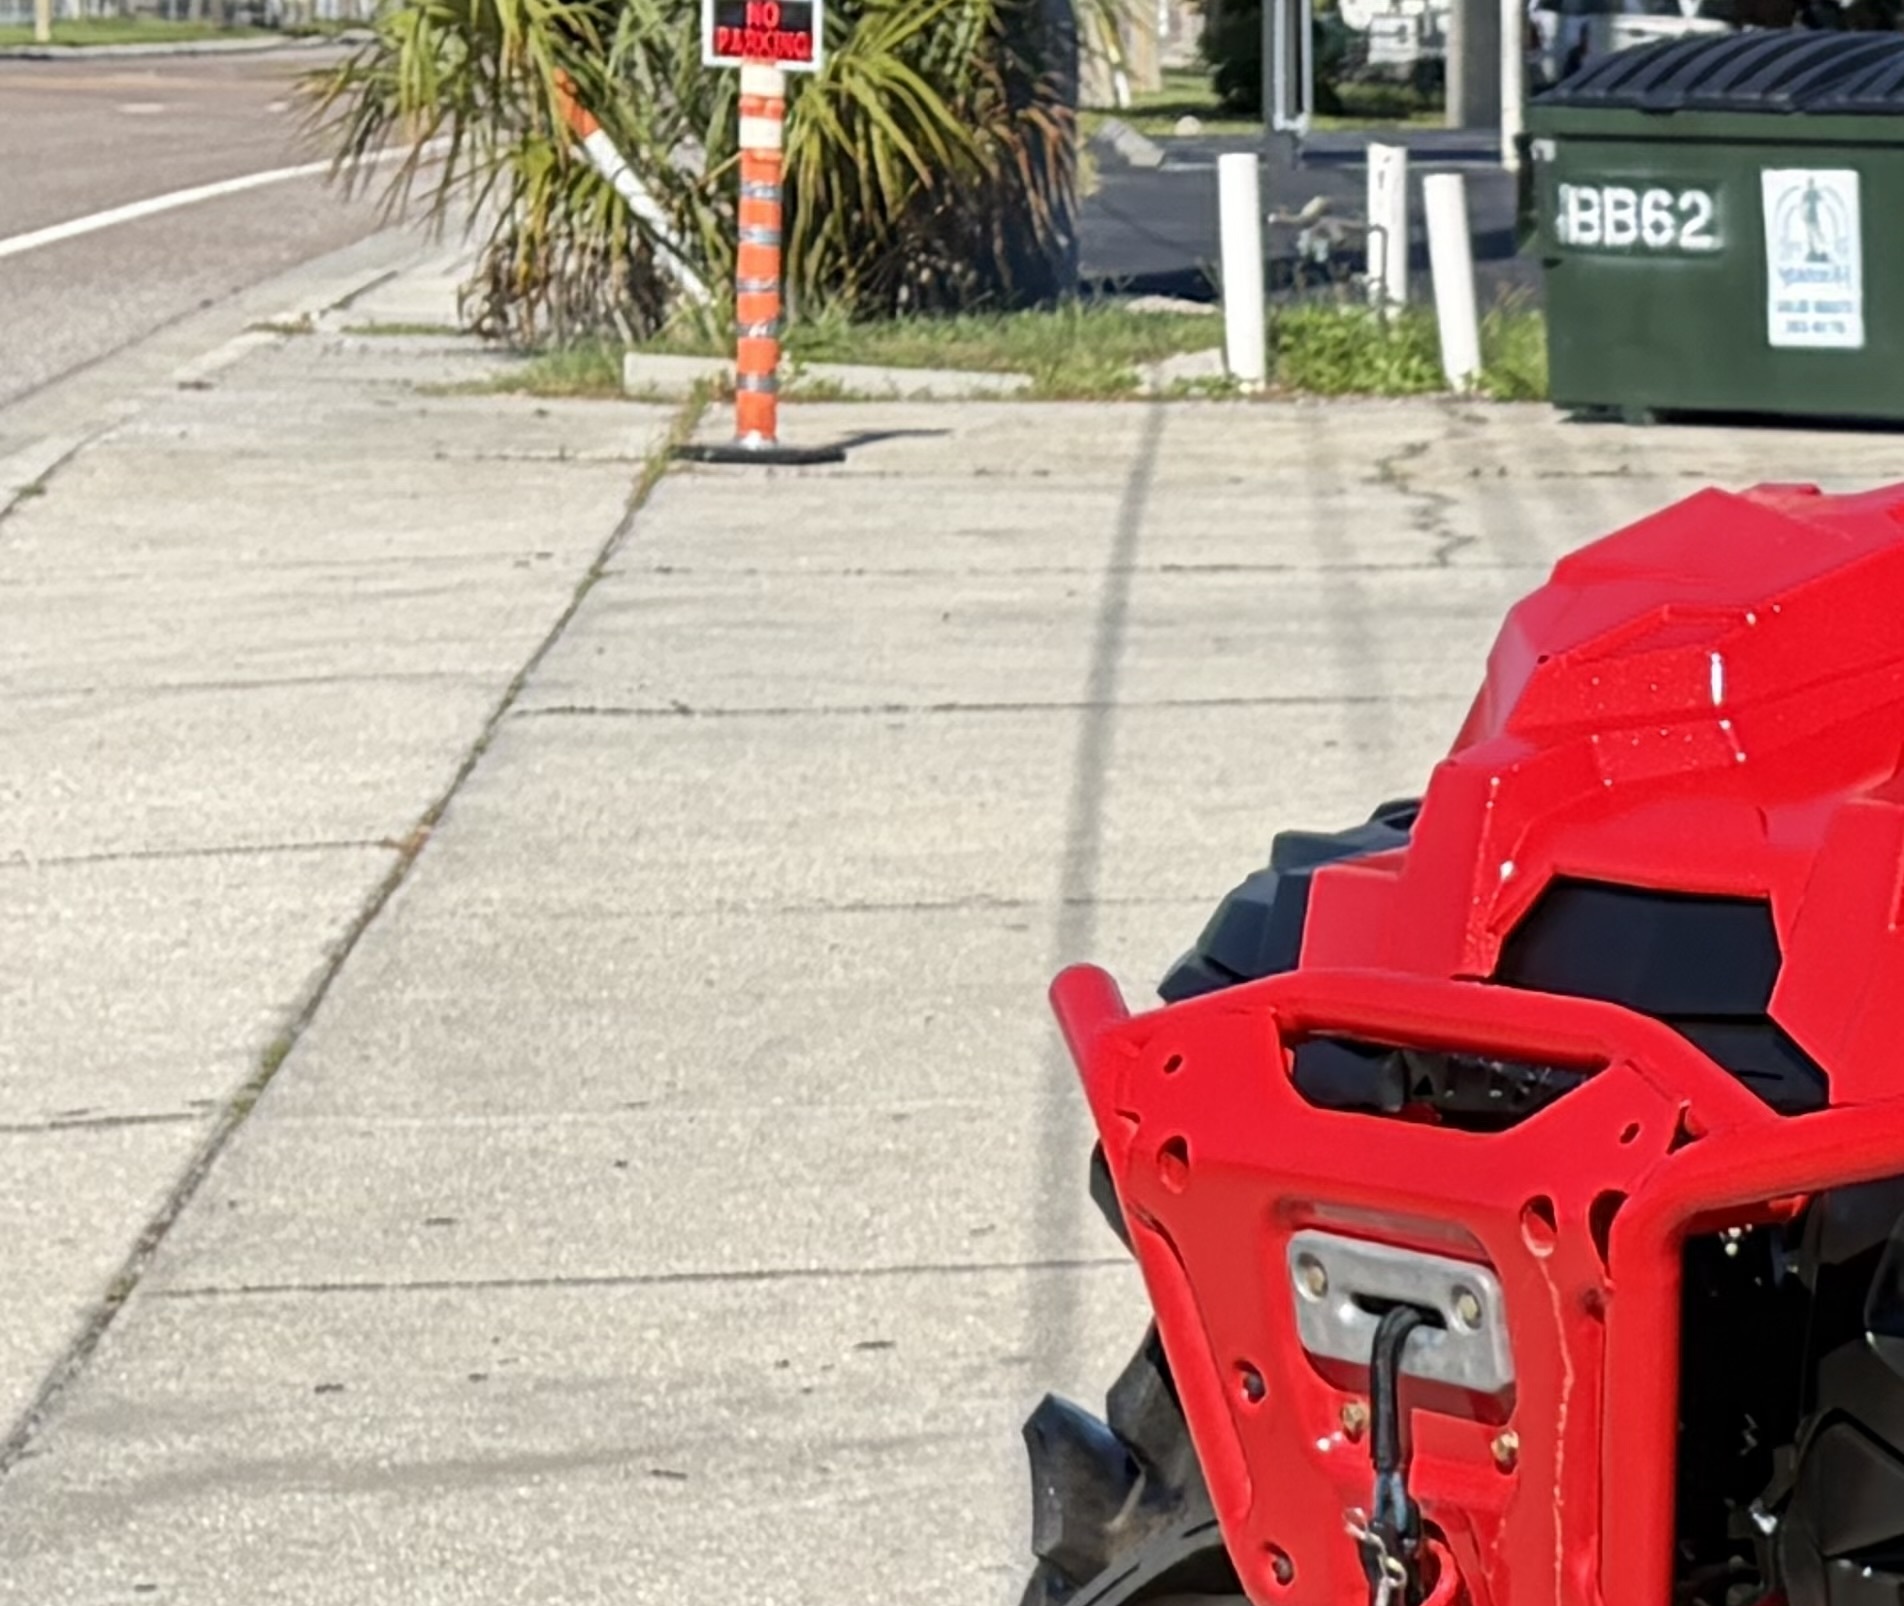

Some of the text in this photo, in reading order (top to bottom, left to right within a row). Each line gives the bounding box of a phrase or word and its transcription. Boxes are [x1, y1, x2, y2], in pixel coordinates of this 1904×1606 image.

[746, 0, 780, 28] NO
[716, 26, 810, 60] PARKING
[1560, 184, 1719, 250] BB62
